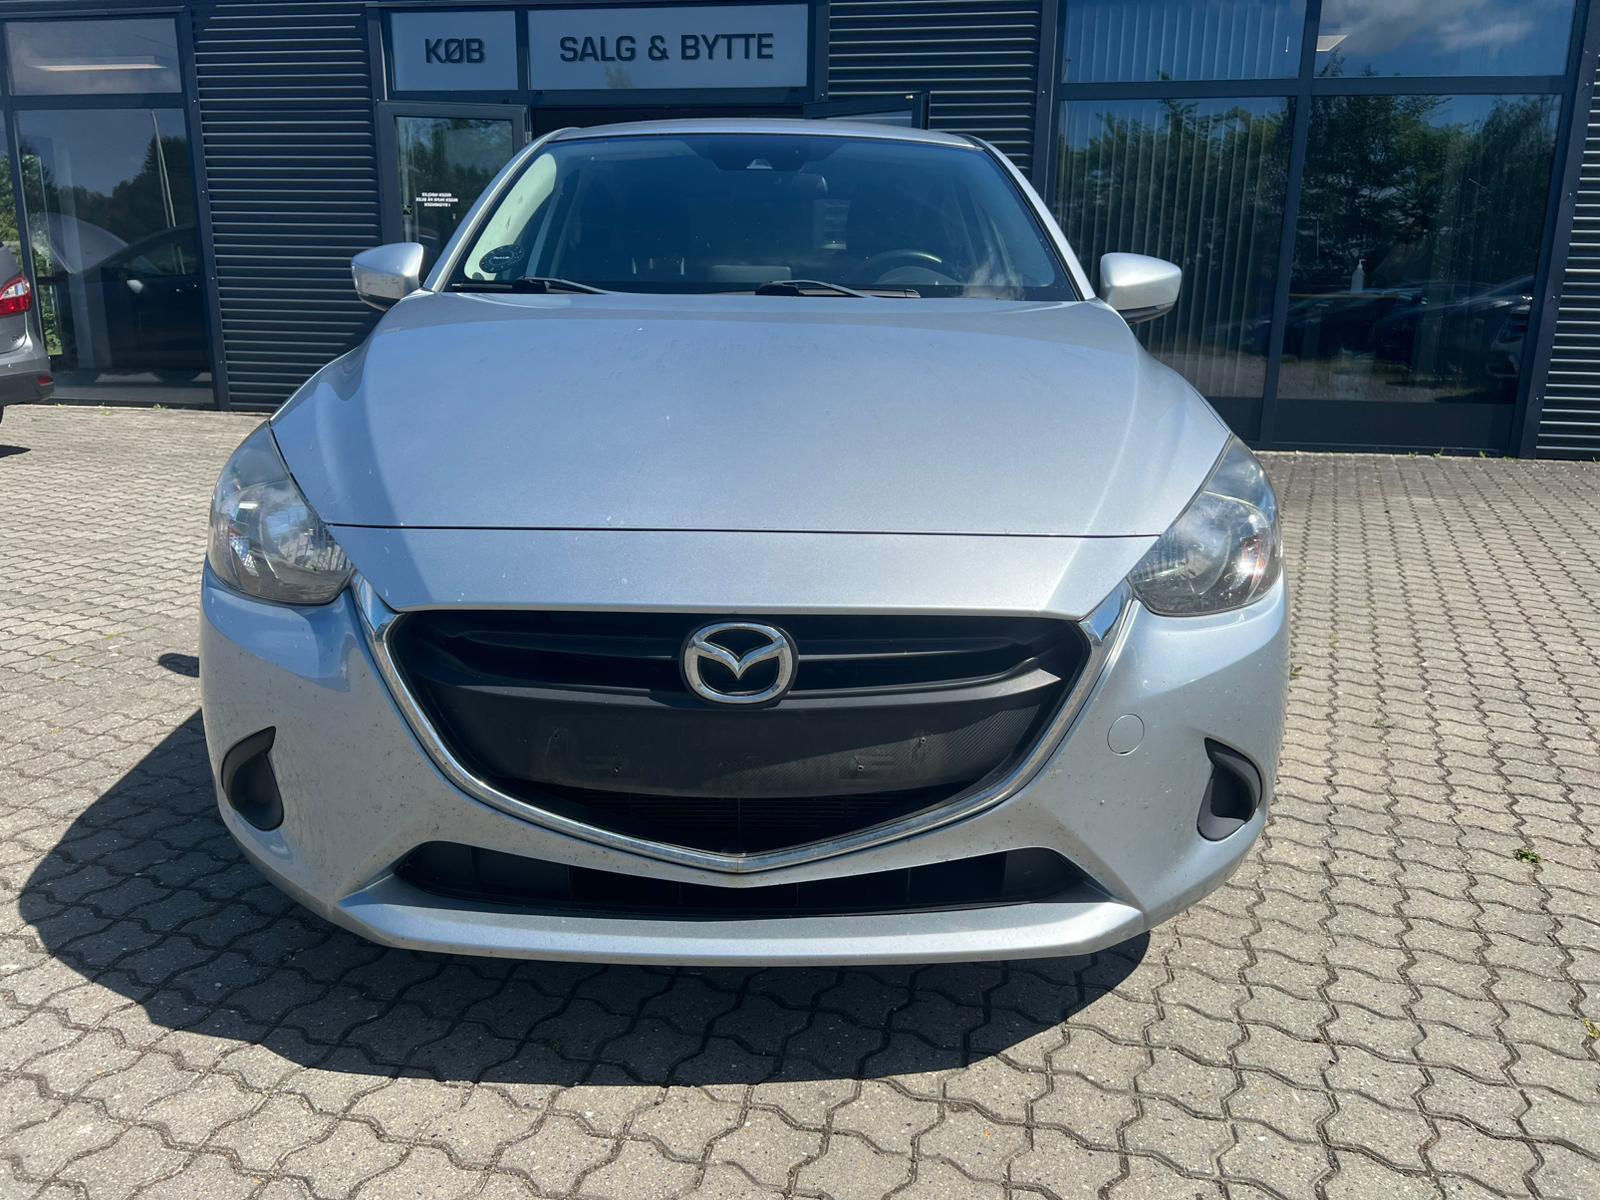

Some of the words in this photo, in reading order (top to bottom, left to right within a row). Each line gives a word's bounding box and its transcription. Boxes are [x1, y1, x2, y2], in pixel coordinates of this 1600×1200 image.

[424, 37, 485, 63] KØB
[559, 35, 636, 62] SALG
[647, 35, 669, 61] &
[680, 33, 774, 60] BYTTE
